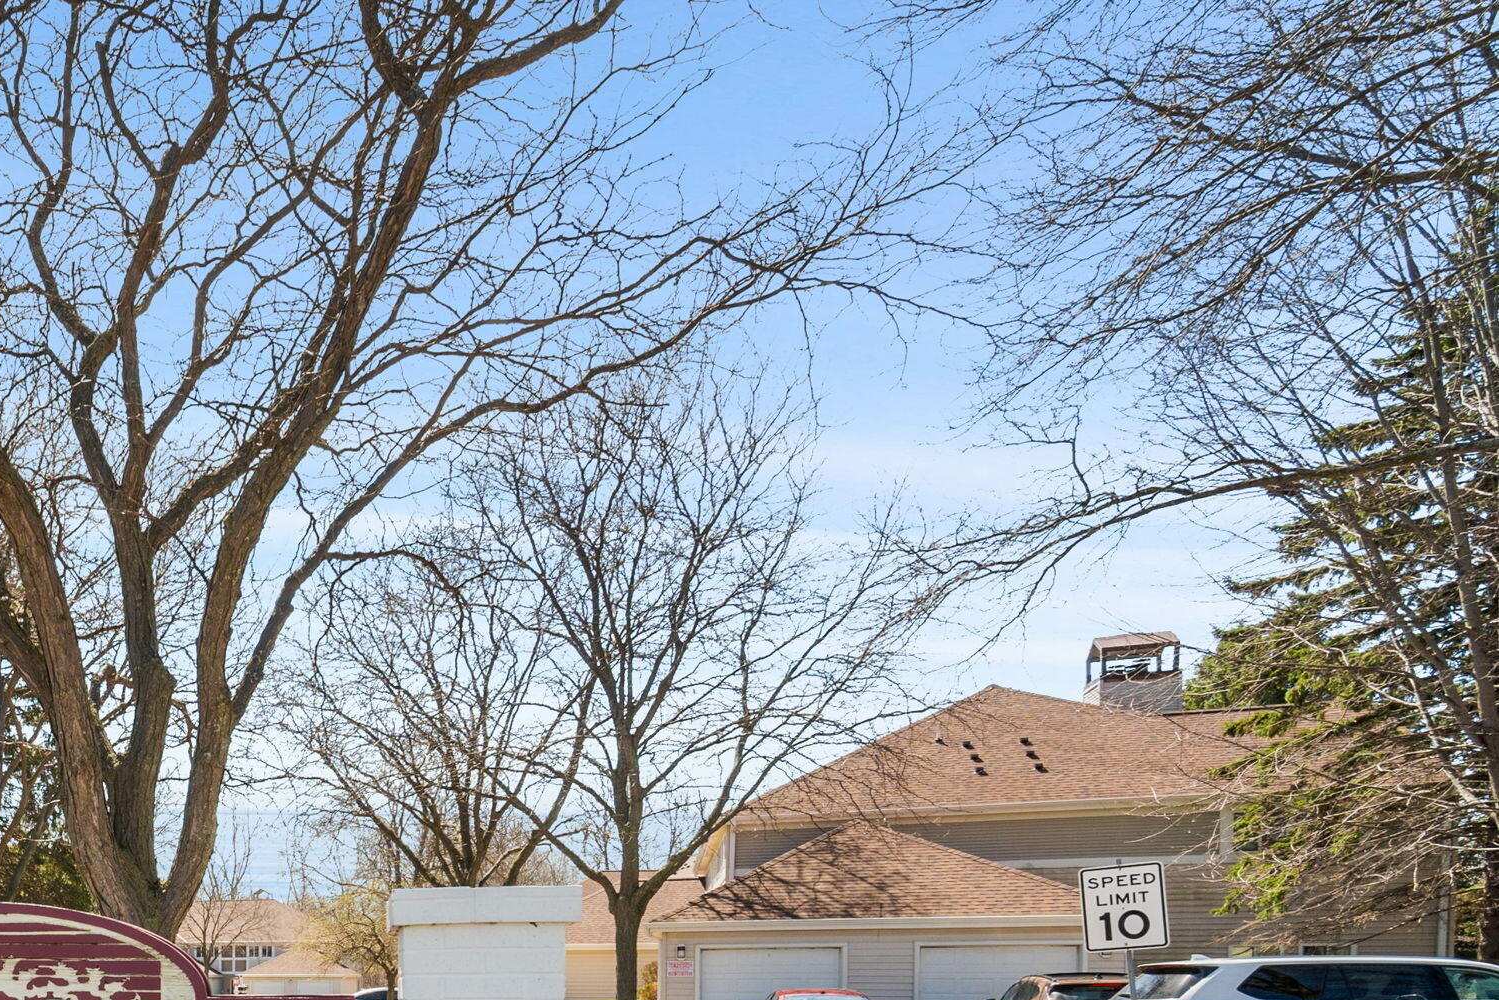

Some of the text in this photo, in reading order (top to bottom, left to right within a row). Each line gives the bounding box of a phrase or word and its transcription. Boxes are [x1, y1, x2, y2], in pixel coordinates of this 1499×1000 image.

[1088, 873, 1156, 889] SPEED
[1096, 891, 1149, 906] LIMIT
[1099, 910, 1150, 941] 10
